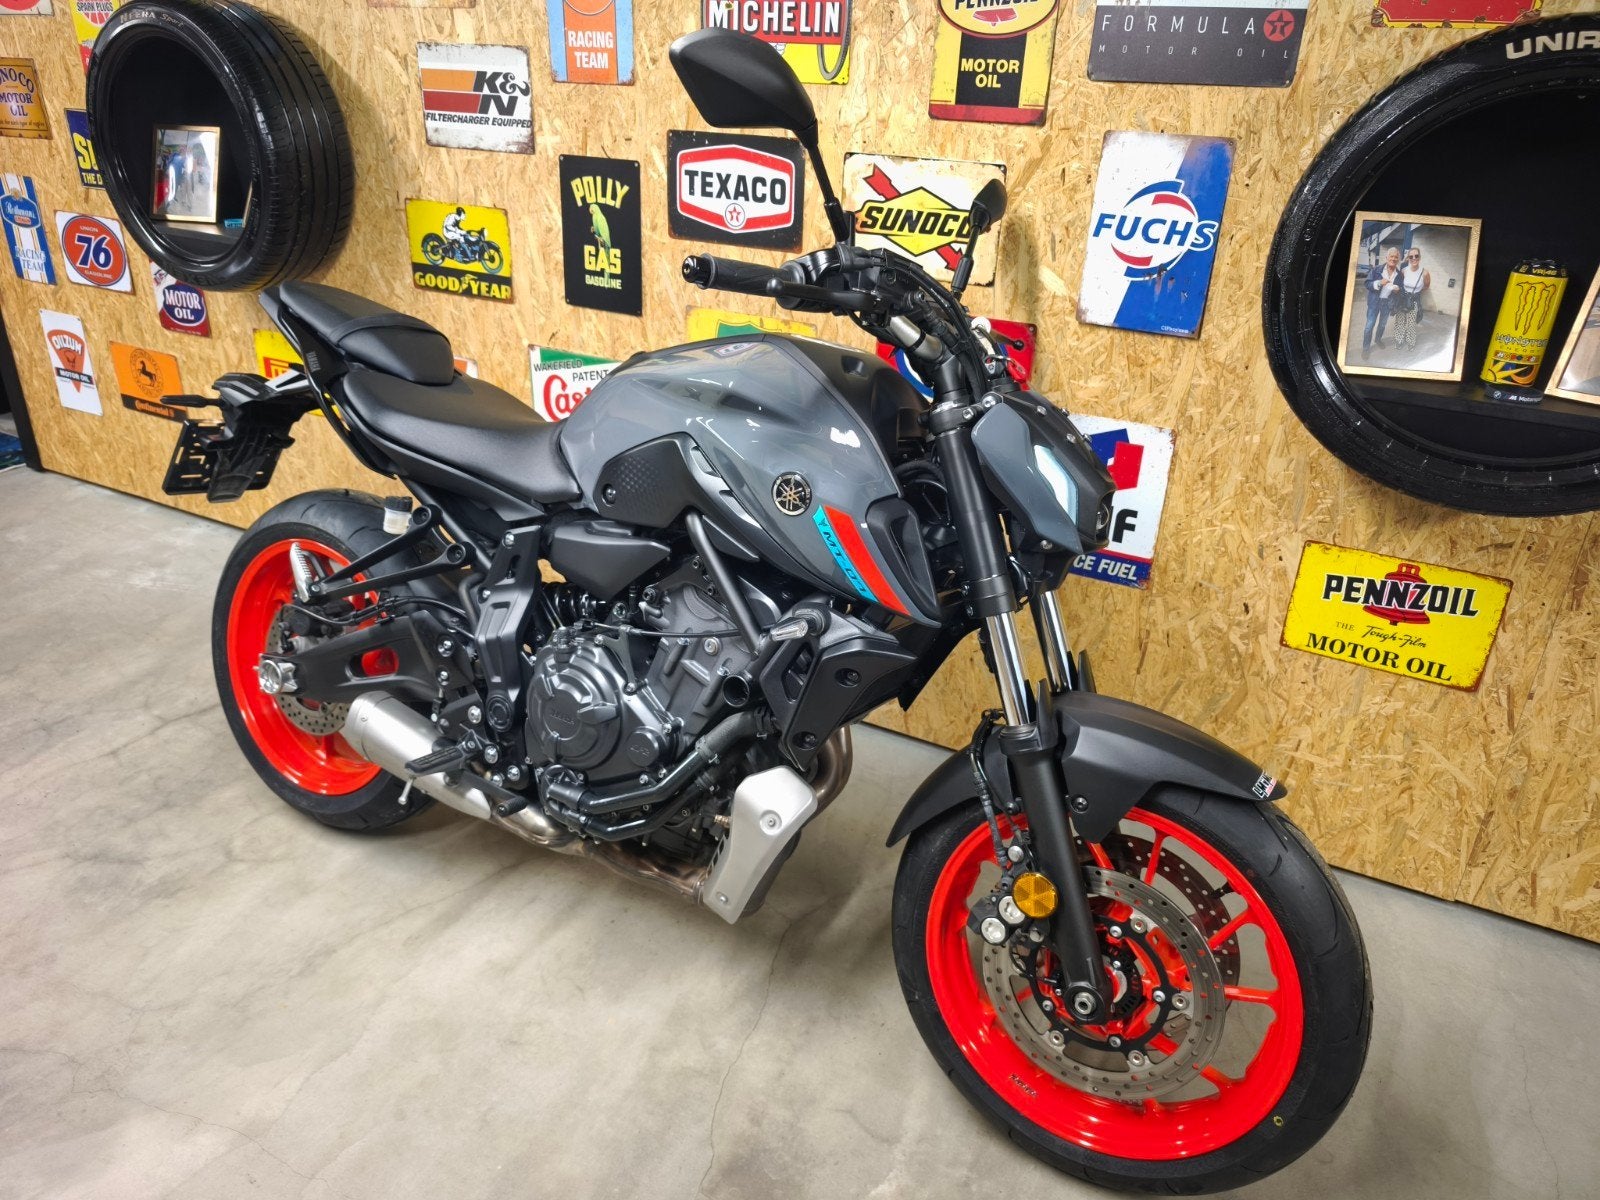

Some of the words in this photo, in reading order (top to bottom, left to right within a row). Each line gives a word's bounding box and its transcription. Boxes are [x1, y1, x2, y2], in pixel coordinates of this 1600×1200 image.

[77, 2, 96, 11] SPARK
[96, 2, 114, 11] PLUGS
[709, 0, 841, 33] MICHELIN
[1102, 14, 1255, 35] FORMULA
[568, 30, 614, 49] RACING
[575, 51, 609, 69] TEAM
[1099, 45, 1198, 56] MOTOR
[1237, 48, 1289, 59] OIL
[961, 58, 1020, 73] MOTOR
[0, 67, 34, 93] NOCO
[975, 74, 1001, 88] OIL
[0, 92, 33, 104] MOTOR
[10, 105, 28, 117] OIL
[426, 112, 490, 126] FILTERCHARGER
[492, 117, 533, 128] EQUIPPED
[570, 175, 630, 209] POLLY
[684, 169, 787, 206] TEXACO
[80, 225, 98, 233] UNION
[1092, 213, 1218, 250] FUCHS
[15, 245, 46, 262] RACING
[75, 233, 113, 270] 76
[583, 245, 622, 275] GAS
[22, 259, 44, 272] TEAM
[85, 270, 113, 280] GASOLINE
[585, 274, 622, 290] GASOLINE
[164, 288, 202, 310] MOTOR
[174, 307, 195, 320] OIL
[51, 334, 82, 354] OILZUM
[534, 360, 583, 372] WAKEFIELD
[59, 369, 80, 381] MOTOR
[80, 374, 90, 383] OIL
[572, 369, 609, 382] PATENT
[1073, 554, 1096, 571] CE
[1097, 558, 1137, 581] FUEL
[1322, 573, 1479, 617] PENNZOIL
[1335, 621, 1355, 632] THE
[1361, 625, 1428, 648] Tough-Film
[1306, 632, 1400, 669] MOTOR
[1405, 657, 1453, 682] OIL
